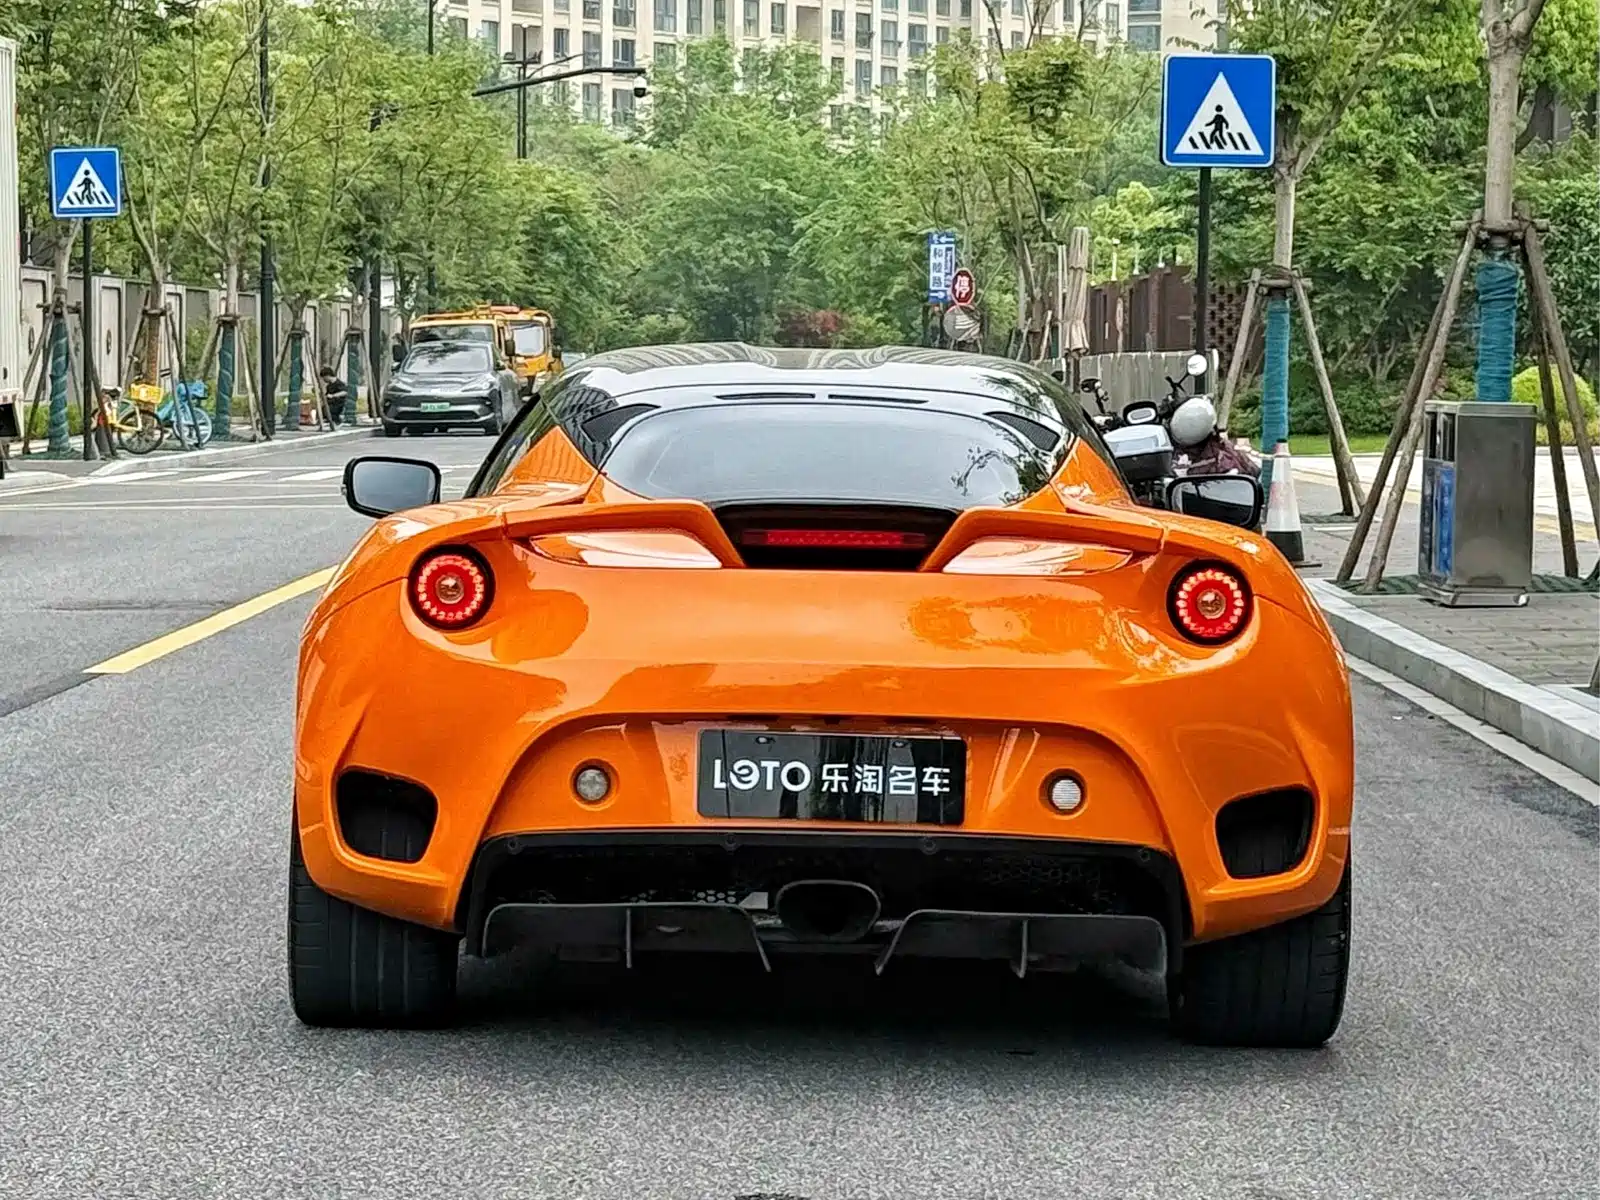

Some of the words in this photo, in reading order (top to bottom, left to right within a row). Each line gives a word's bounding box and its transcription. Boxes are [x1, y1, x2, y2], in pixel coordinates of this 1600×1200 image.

[955, 275, 970, 298] 停
[713, 759, 811, 792] LOTO
[821, 763, 950, 797] 乐淘名车
